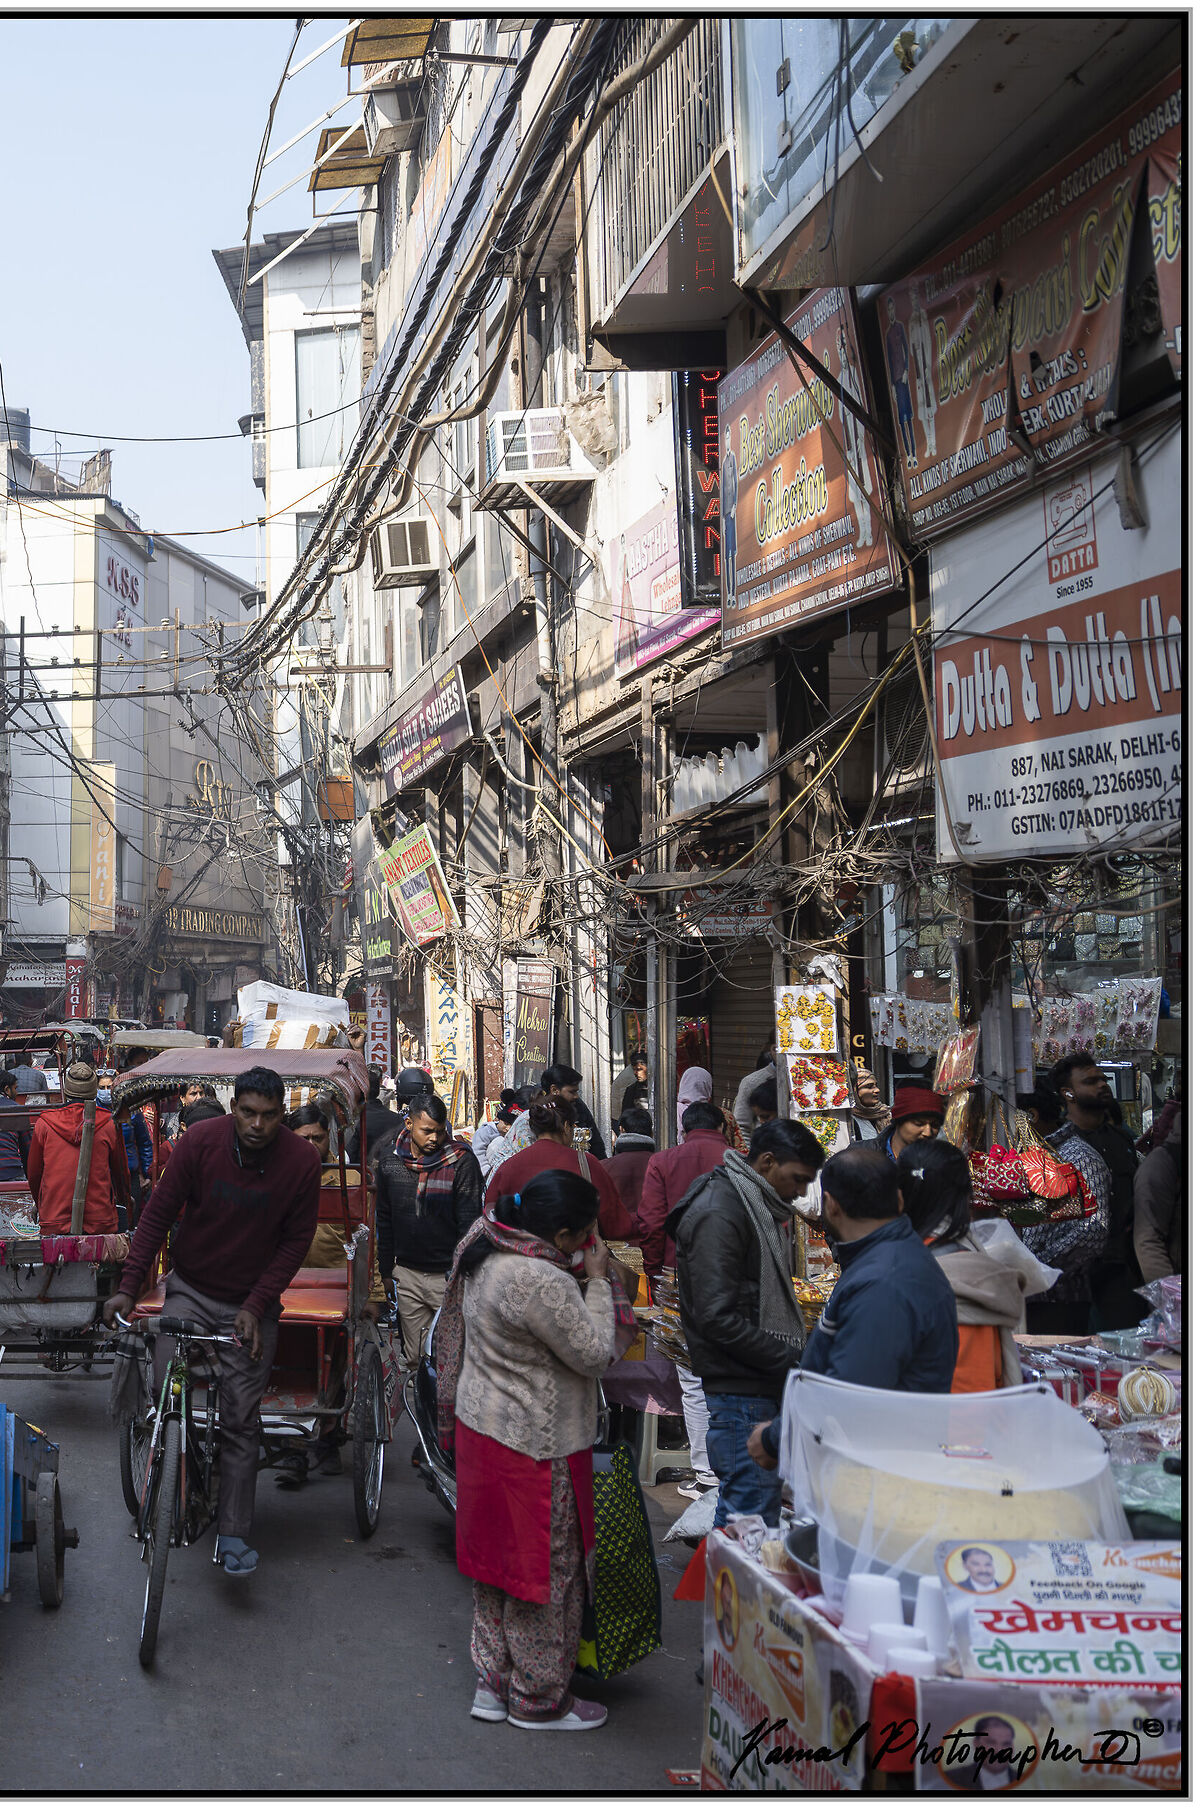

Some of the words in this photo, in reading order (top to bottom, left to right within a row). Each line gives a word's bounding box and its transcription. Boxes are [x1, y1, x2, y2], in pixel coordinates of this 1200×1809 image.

[738, 413, 765, 478] Best
[766, 350, 835, 459] Sherwani
[910, 470, 922, 499] ALL
[923, 464, 941, 494] KINDS
[941, 460, 949, 485] OF
[950, 436, 990, 480] SHERWANI,
[755, 458, 828, 545] Collection
[788, 540, 799, 562] ALL
[814, 528, 822, 549] OF
[842, 542, 857, 564] ETC.
[1051, 545, 1094, 579] DATTA
[1056, 583, 1074, 599] Since
[1075, 575, 1093, 594] 1955
[941, 647, 1013, 740] Dutta
[1020, 633, 1041, 723] &
[1046, 611, 1137, 716] Dutta
[402, 718, 422, 756] SILK
[425, 680, 461, 735] SAREES
[1011, 755, 1038, 778] 887,
[1041, 749, 1065, 773] NAI
[1068, 741, 1118, 768] SARAK,
[1120, 730, 1180, 759] DELHI-6
[967, 792, 991, 812] PH.:
[993, 777, 1089, 809] 011-23276869,
[1092, 765, 1168, 797] 23266950,
[1011, 811, 1056, 836] GSTIN:
[383, 856, 406, 887] ANANT
[403, 838, 432, 875] TEXTILES
[181, 909, 220, 934] TRADING
[222, 914, 263, 938] COMPANY
[517, 996, 548, 1034] Mehra
[1031, 1580, 1083, 1589] Feedback
[1086, 1580, 1103, 1588] On
[1105, 1580, 1146, 1590] Google
[780, 1618, 804, 1649] FAMOUS
[973, 1637, 1082, 1674] दौलत
[1090, 1639, 1147, 1675] की
